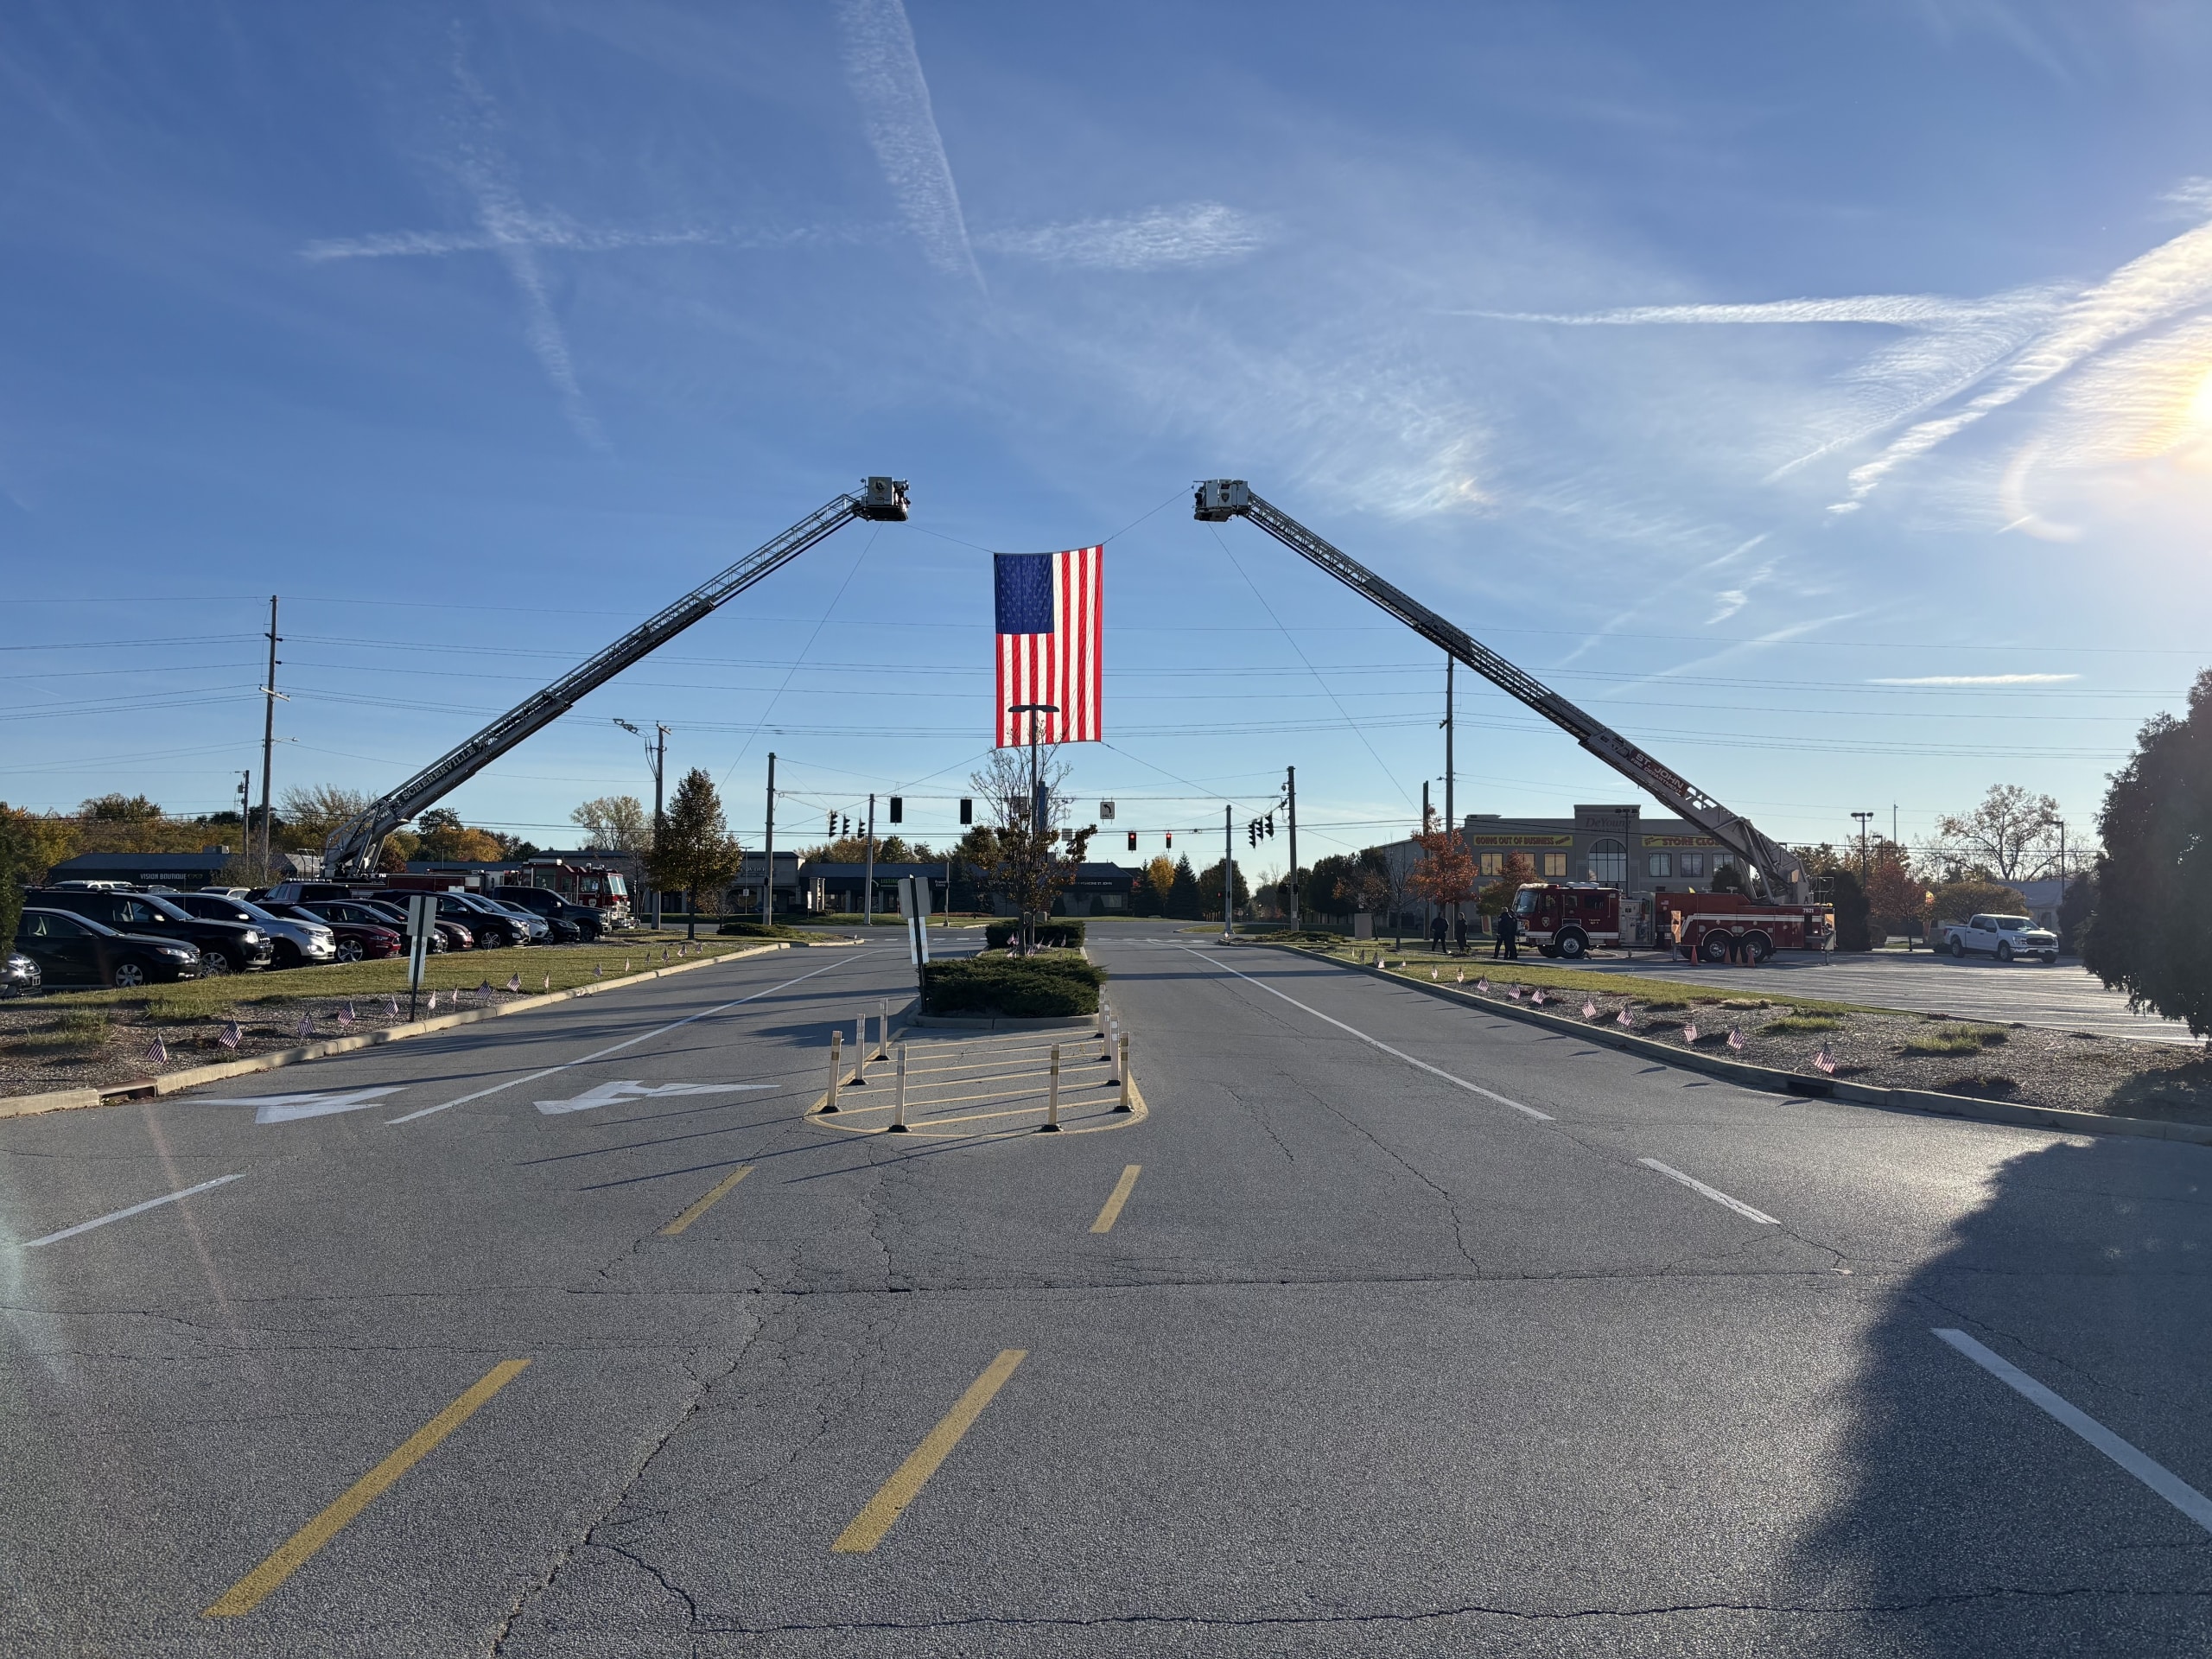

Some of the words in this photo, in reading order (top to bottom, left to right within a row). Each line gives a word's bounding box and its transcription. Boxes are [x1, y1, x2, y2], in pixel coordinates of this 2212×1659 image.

[402, 746, 476, 800] SCHERERVILLE
[1630, 758, 1643, 768] FIRE
[1643, 766, 1682, 794] DEPARTMENT
[1635, 753, 1651, 767] ST.
[1654, 765, 1685, 789] JOHN
[1475, 836, 1497, 845] GOING
[1498, 836, 1513, 845] OUT
[1513, 836, 1522, 845] OF
[1523, 836, 1554, 845] BUSINESS
[1662, 837, 1694, 846] STORE
